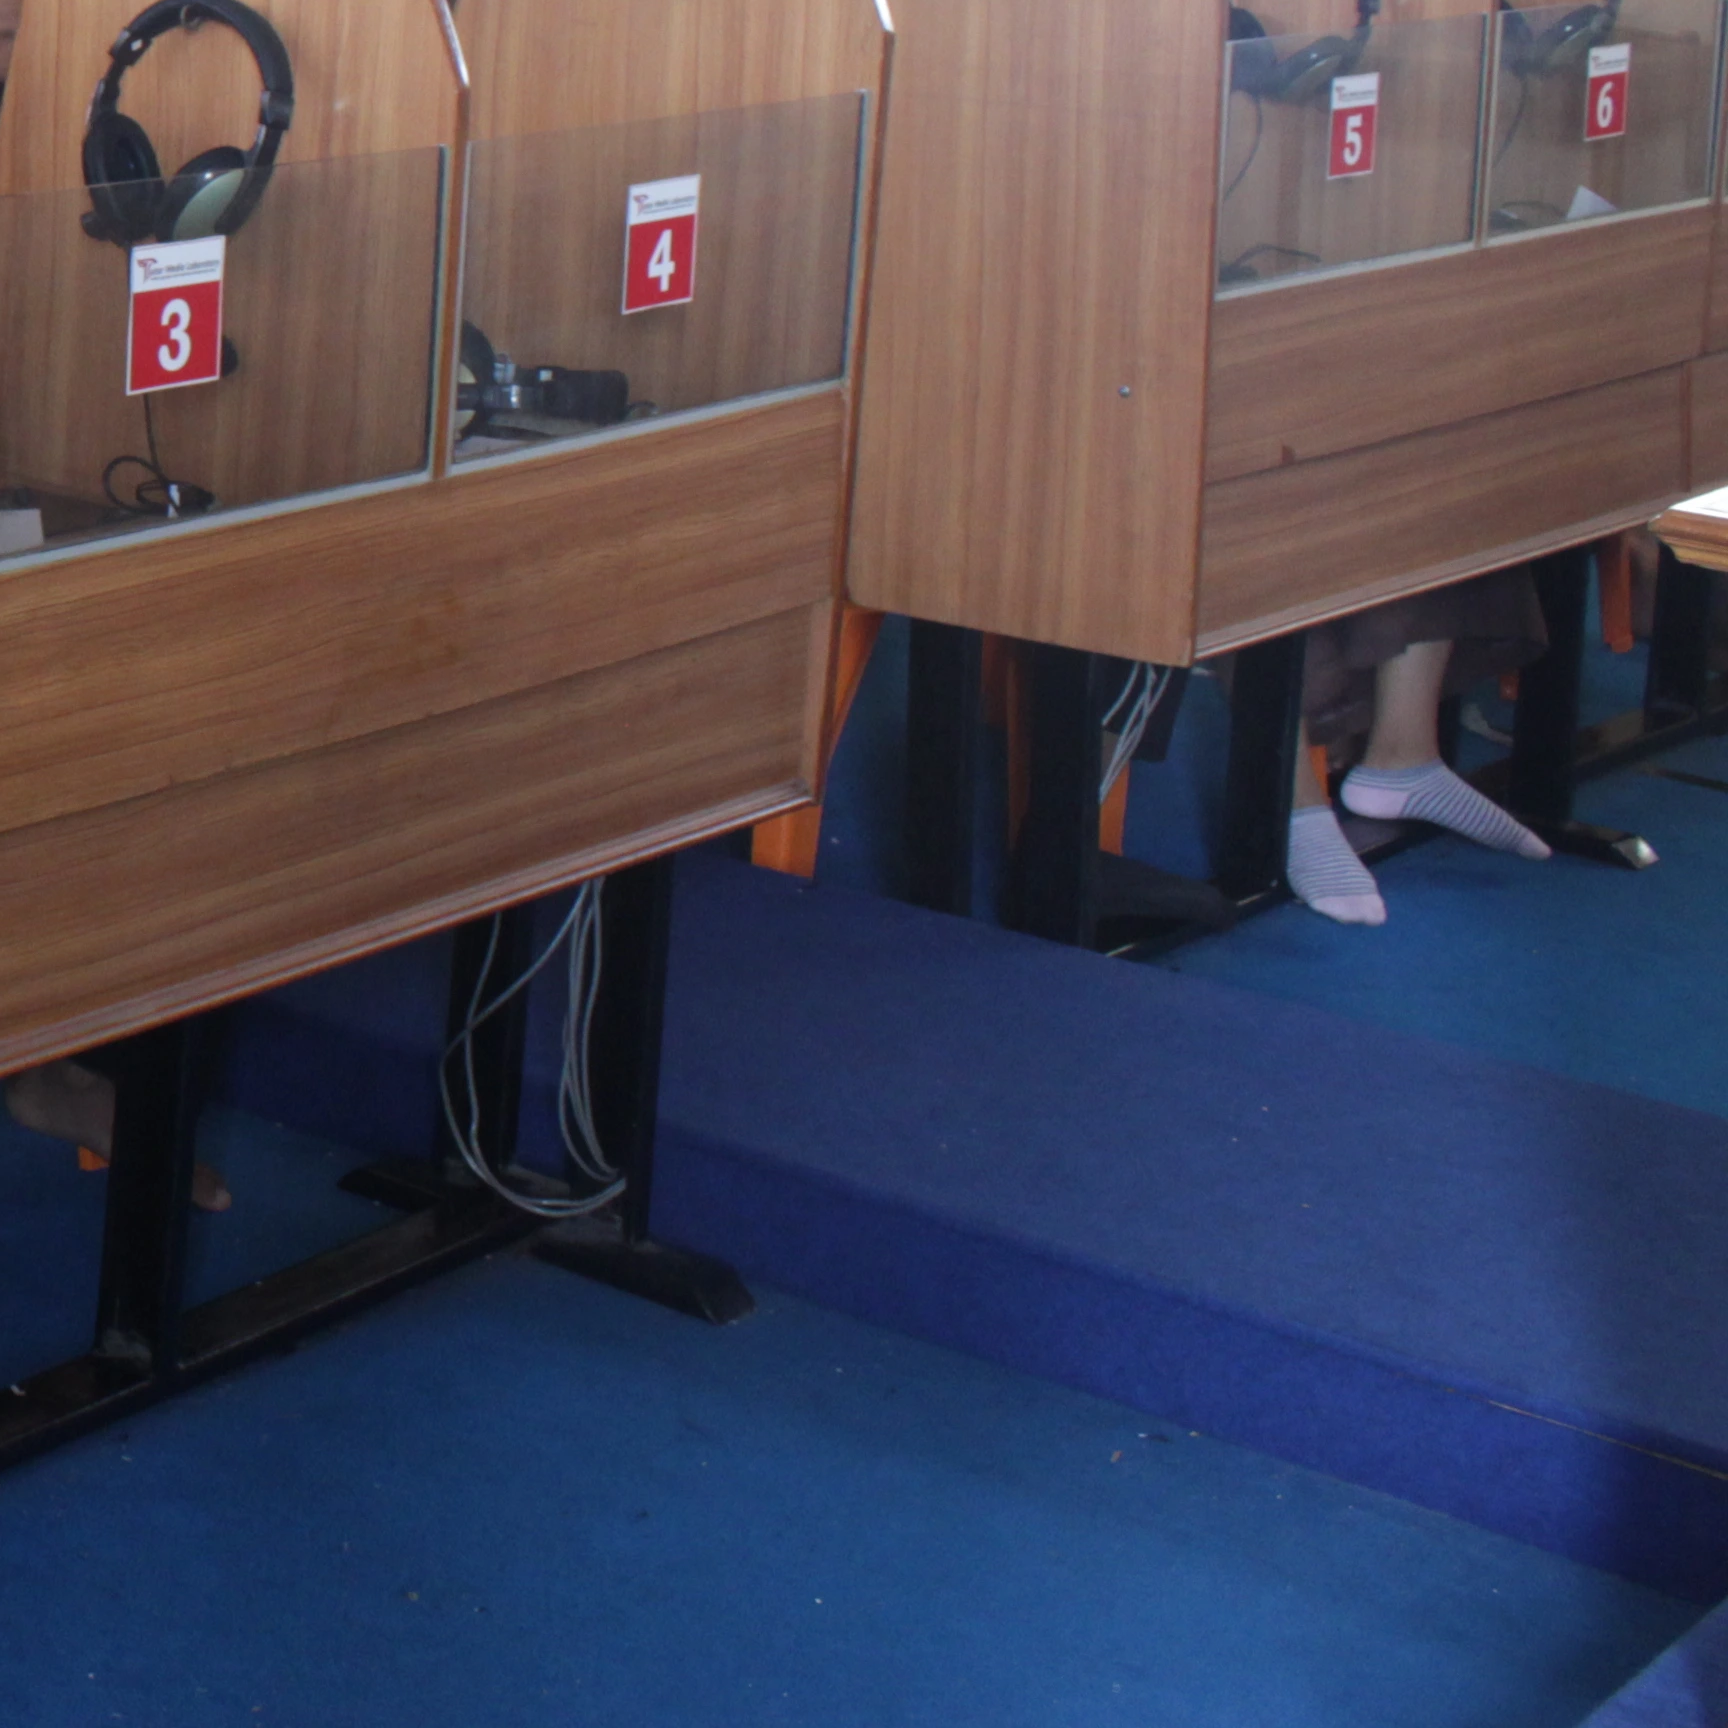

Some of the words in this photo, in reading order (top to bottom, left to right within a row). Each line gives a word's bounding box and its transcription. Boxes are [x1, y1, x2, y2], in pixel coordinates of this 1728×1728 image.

[1597, 81, 1614, 129] 6
[1343, 113, 1363, 166] 5
[648, 228, 676, 292] 4
[157, 298, 192, 372] 3
